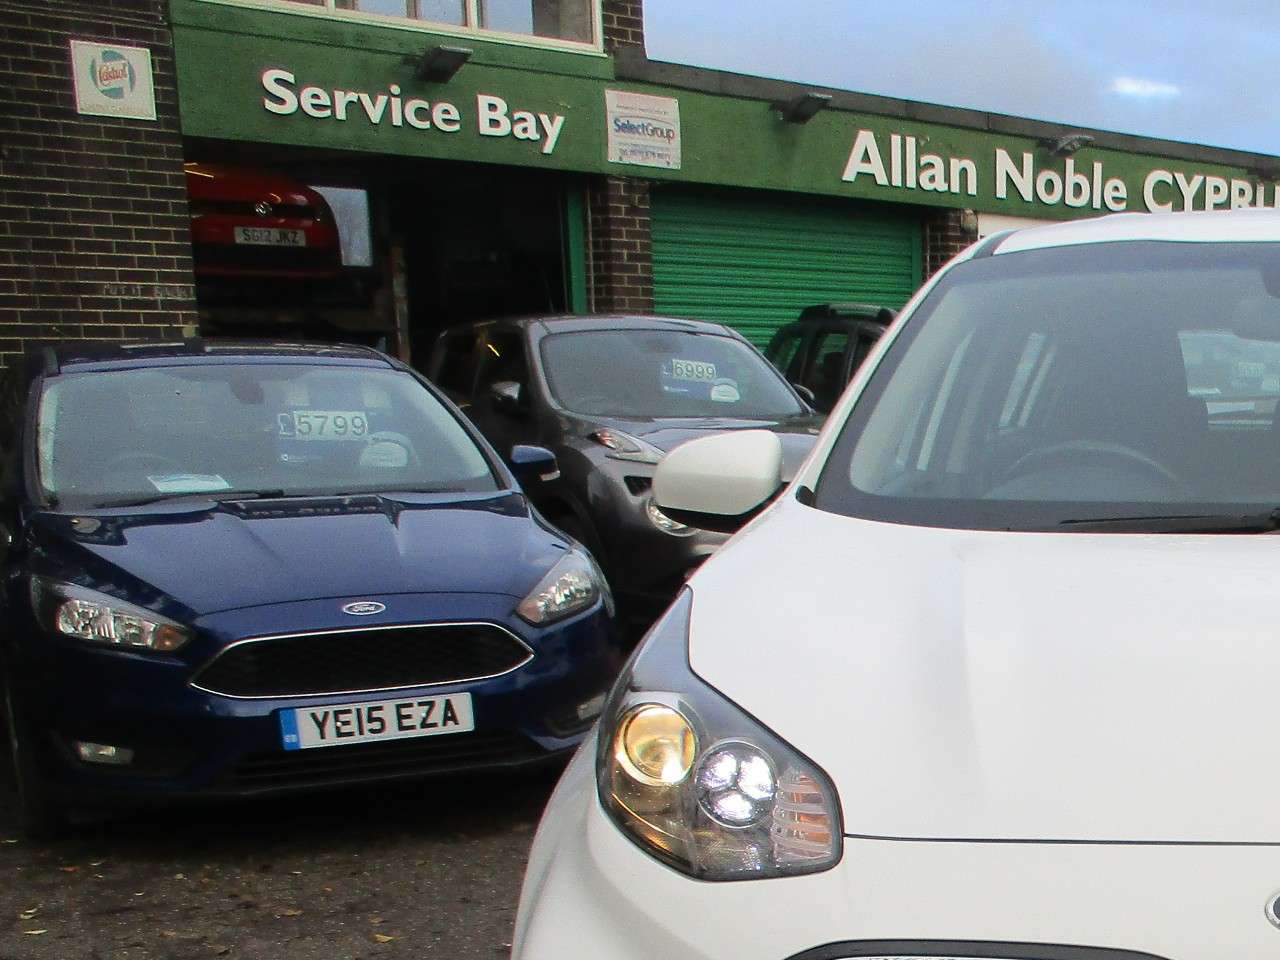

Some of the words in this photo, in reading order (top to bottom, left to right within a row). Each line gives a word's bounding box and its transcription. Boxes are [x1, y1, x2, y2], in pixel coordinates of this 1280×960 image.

[261, 69, 462, 133] Service
[476, 94, 566, 155] Bay
[613, 117, 675, 144] SelectGroup
[841, 129, 978, 197] Allan
[995, 148, 1128, 212] Noble
[278, 412, 367, 438] £5799
[310, 704, 387, 740] YE15
[395, 698, 460, 732] EZA
